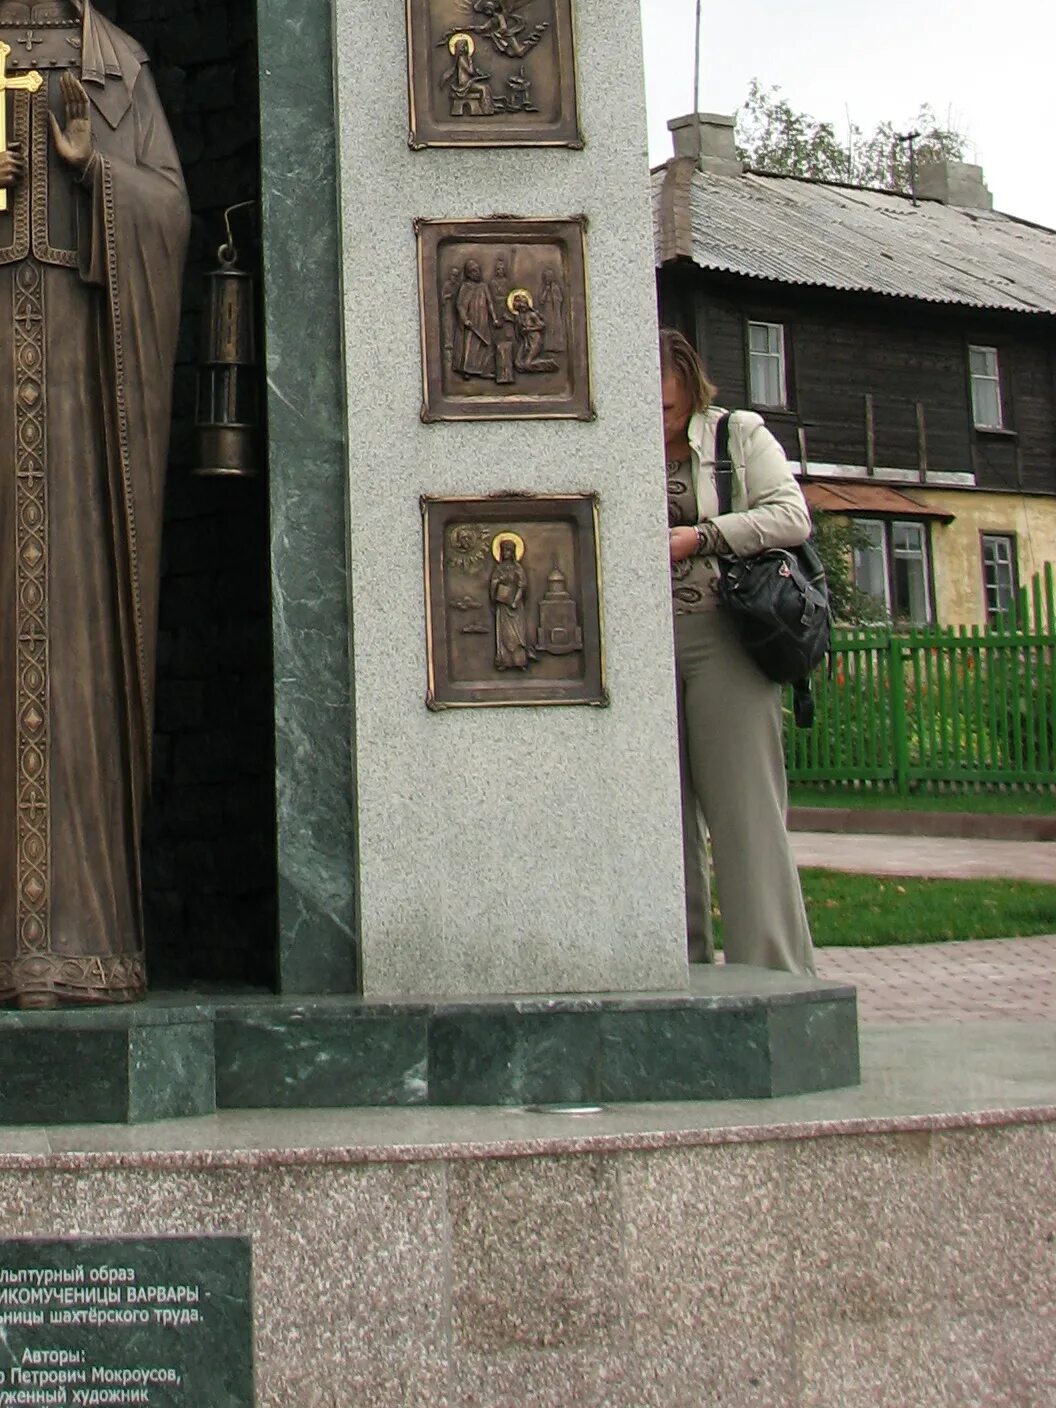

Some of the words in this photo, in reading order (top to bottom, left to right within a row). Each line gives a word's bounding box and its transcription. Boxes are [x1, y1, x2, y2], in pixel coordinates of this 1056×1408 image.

[89, 1265, 135, 1285] образ
[127, 1285, 199, 1303] ВАРВАРЫ
[50, 1307, 150, 1326] шахтёрского
[153, 1308, 204, 1326] труда.
[21, 1348, 86, 1366] Авторы:
[10, 1367, 86, 1387] Петрович
[91, 1366, 181, 1386] Мокроусов,
[72, 1388, 149, 1406] художник
